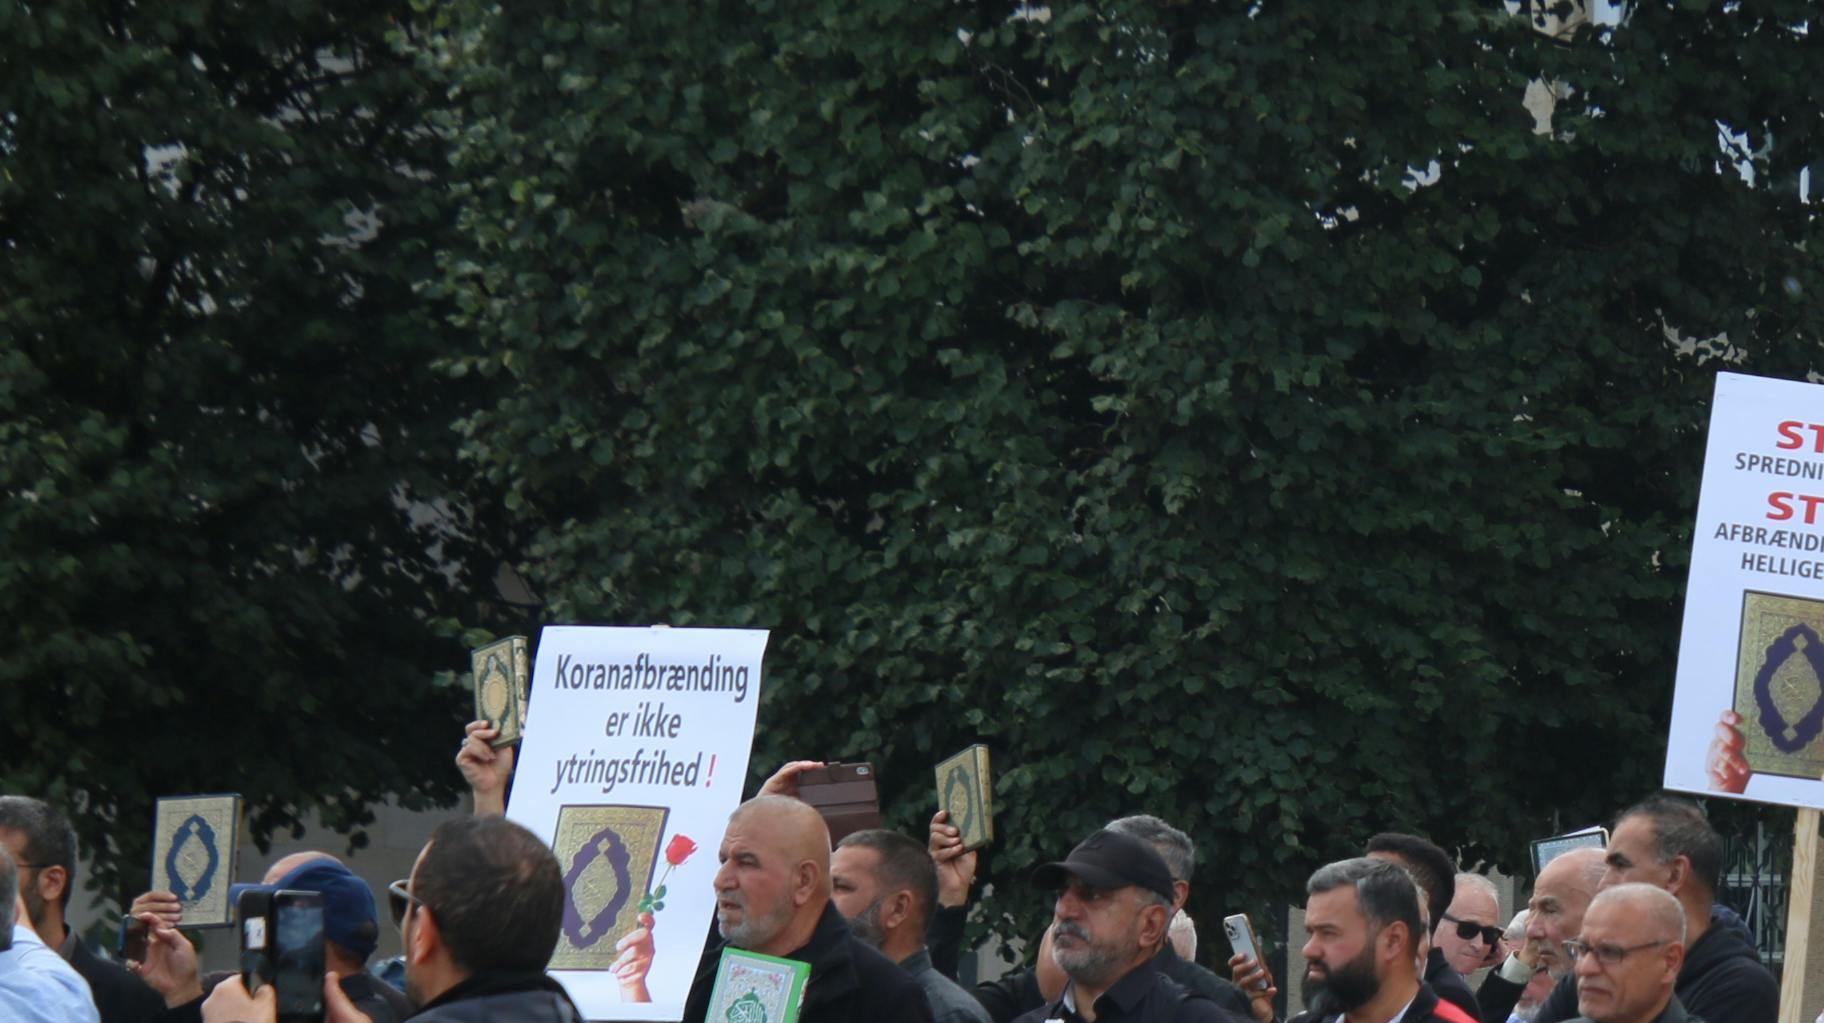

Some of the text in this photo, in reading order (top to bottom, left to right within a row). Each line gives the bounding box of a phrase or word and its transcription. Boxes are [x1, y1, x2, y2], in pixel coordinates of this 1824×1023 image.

[1741, 552, 1824, 580] HELLIGE
[555, 653, 749, 703] Koranafbrænding
[606, 702, 681, 739] er ikke
[550, 748, 716, 794] ytringsfrihed !
